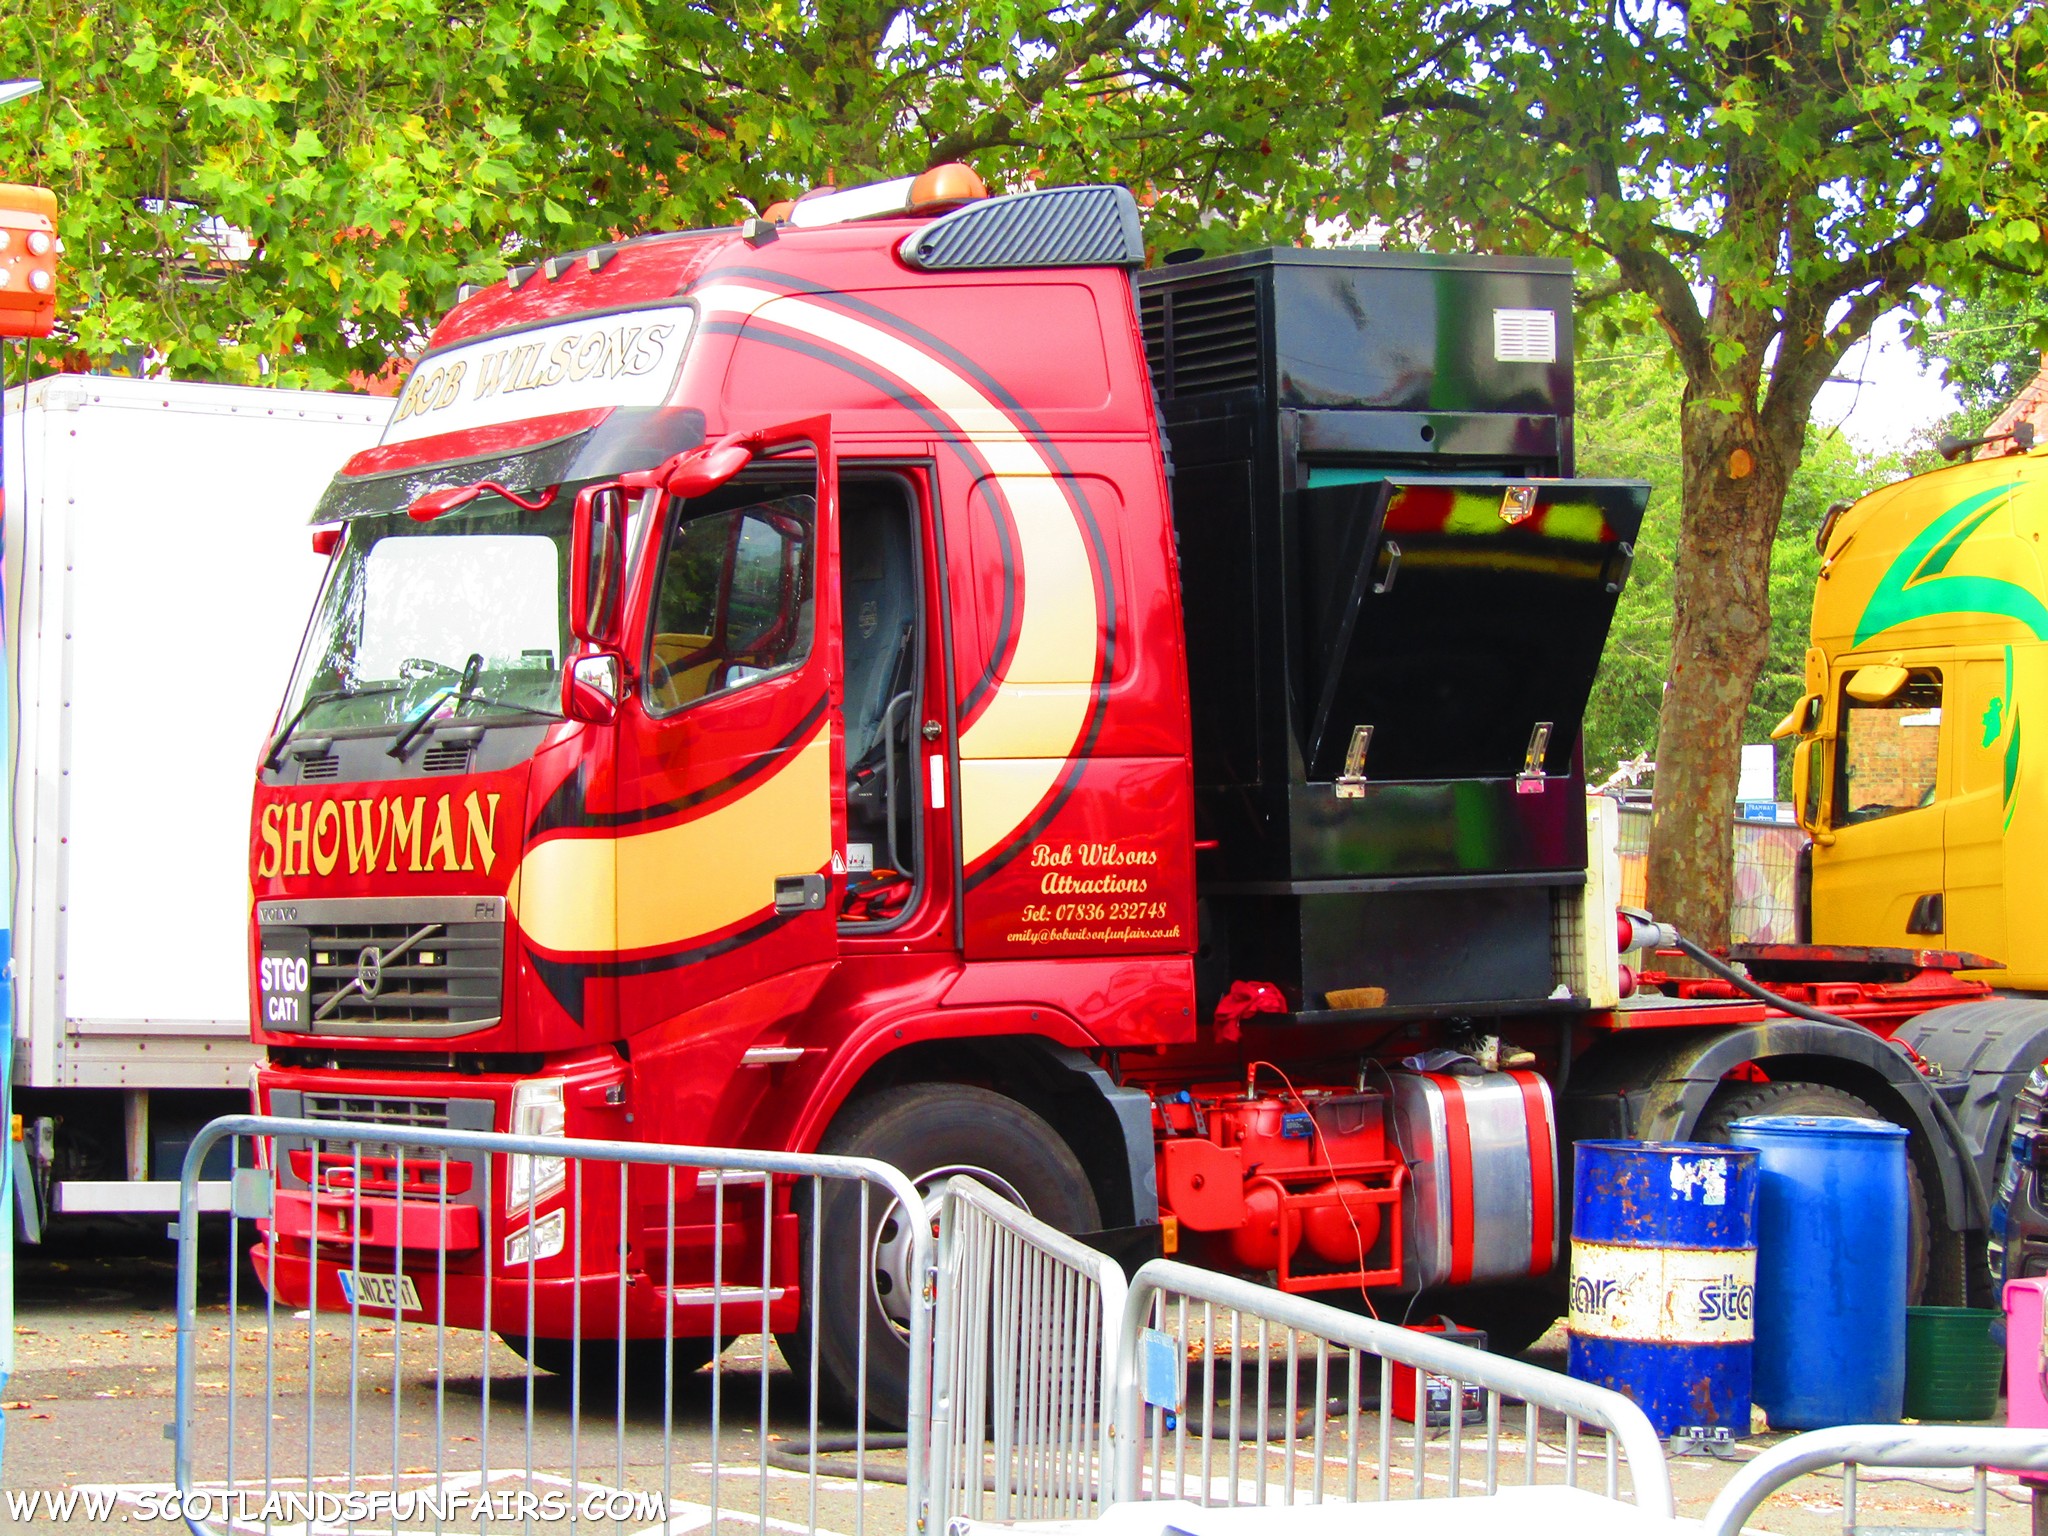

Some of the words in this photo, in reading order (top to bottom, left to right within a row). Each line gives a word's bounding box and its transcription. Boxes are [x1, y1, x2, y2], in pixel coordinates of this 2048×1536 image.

[393, 360, 468, 424] BOB
[473, 324, 675, 401] WILSONS
[257, 790, 501, 879] SHOWMAN
[1030, 844, 1073, 867] Bob
[1078, 843, 1157, 866] Wilsons
[1040, 871, 1148, 895] Attractions
[259, 906, 298, 922] VOLVO
[474, 902, 496, 919] FH
[1021, 904, 1052, 923] Tel:
[1055, 903, 1105, 921] 07836
[1109, 902, 1167, 920] 232748
[1006, 924, 1181, 945] emily@bobwilsonfunfairs.co.uk
[260, 956, 309, 992] STGO
[268, 995, 300, 1022] CAT1
